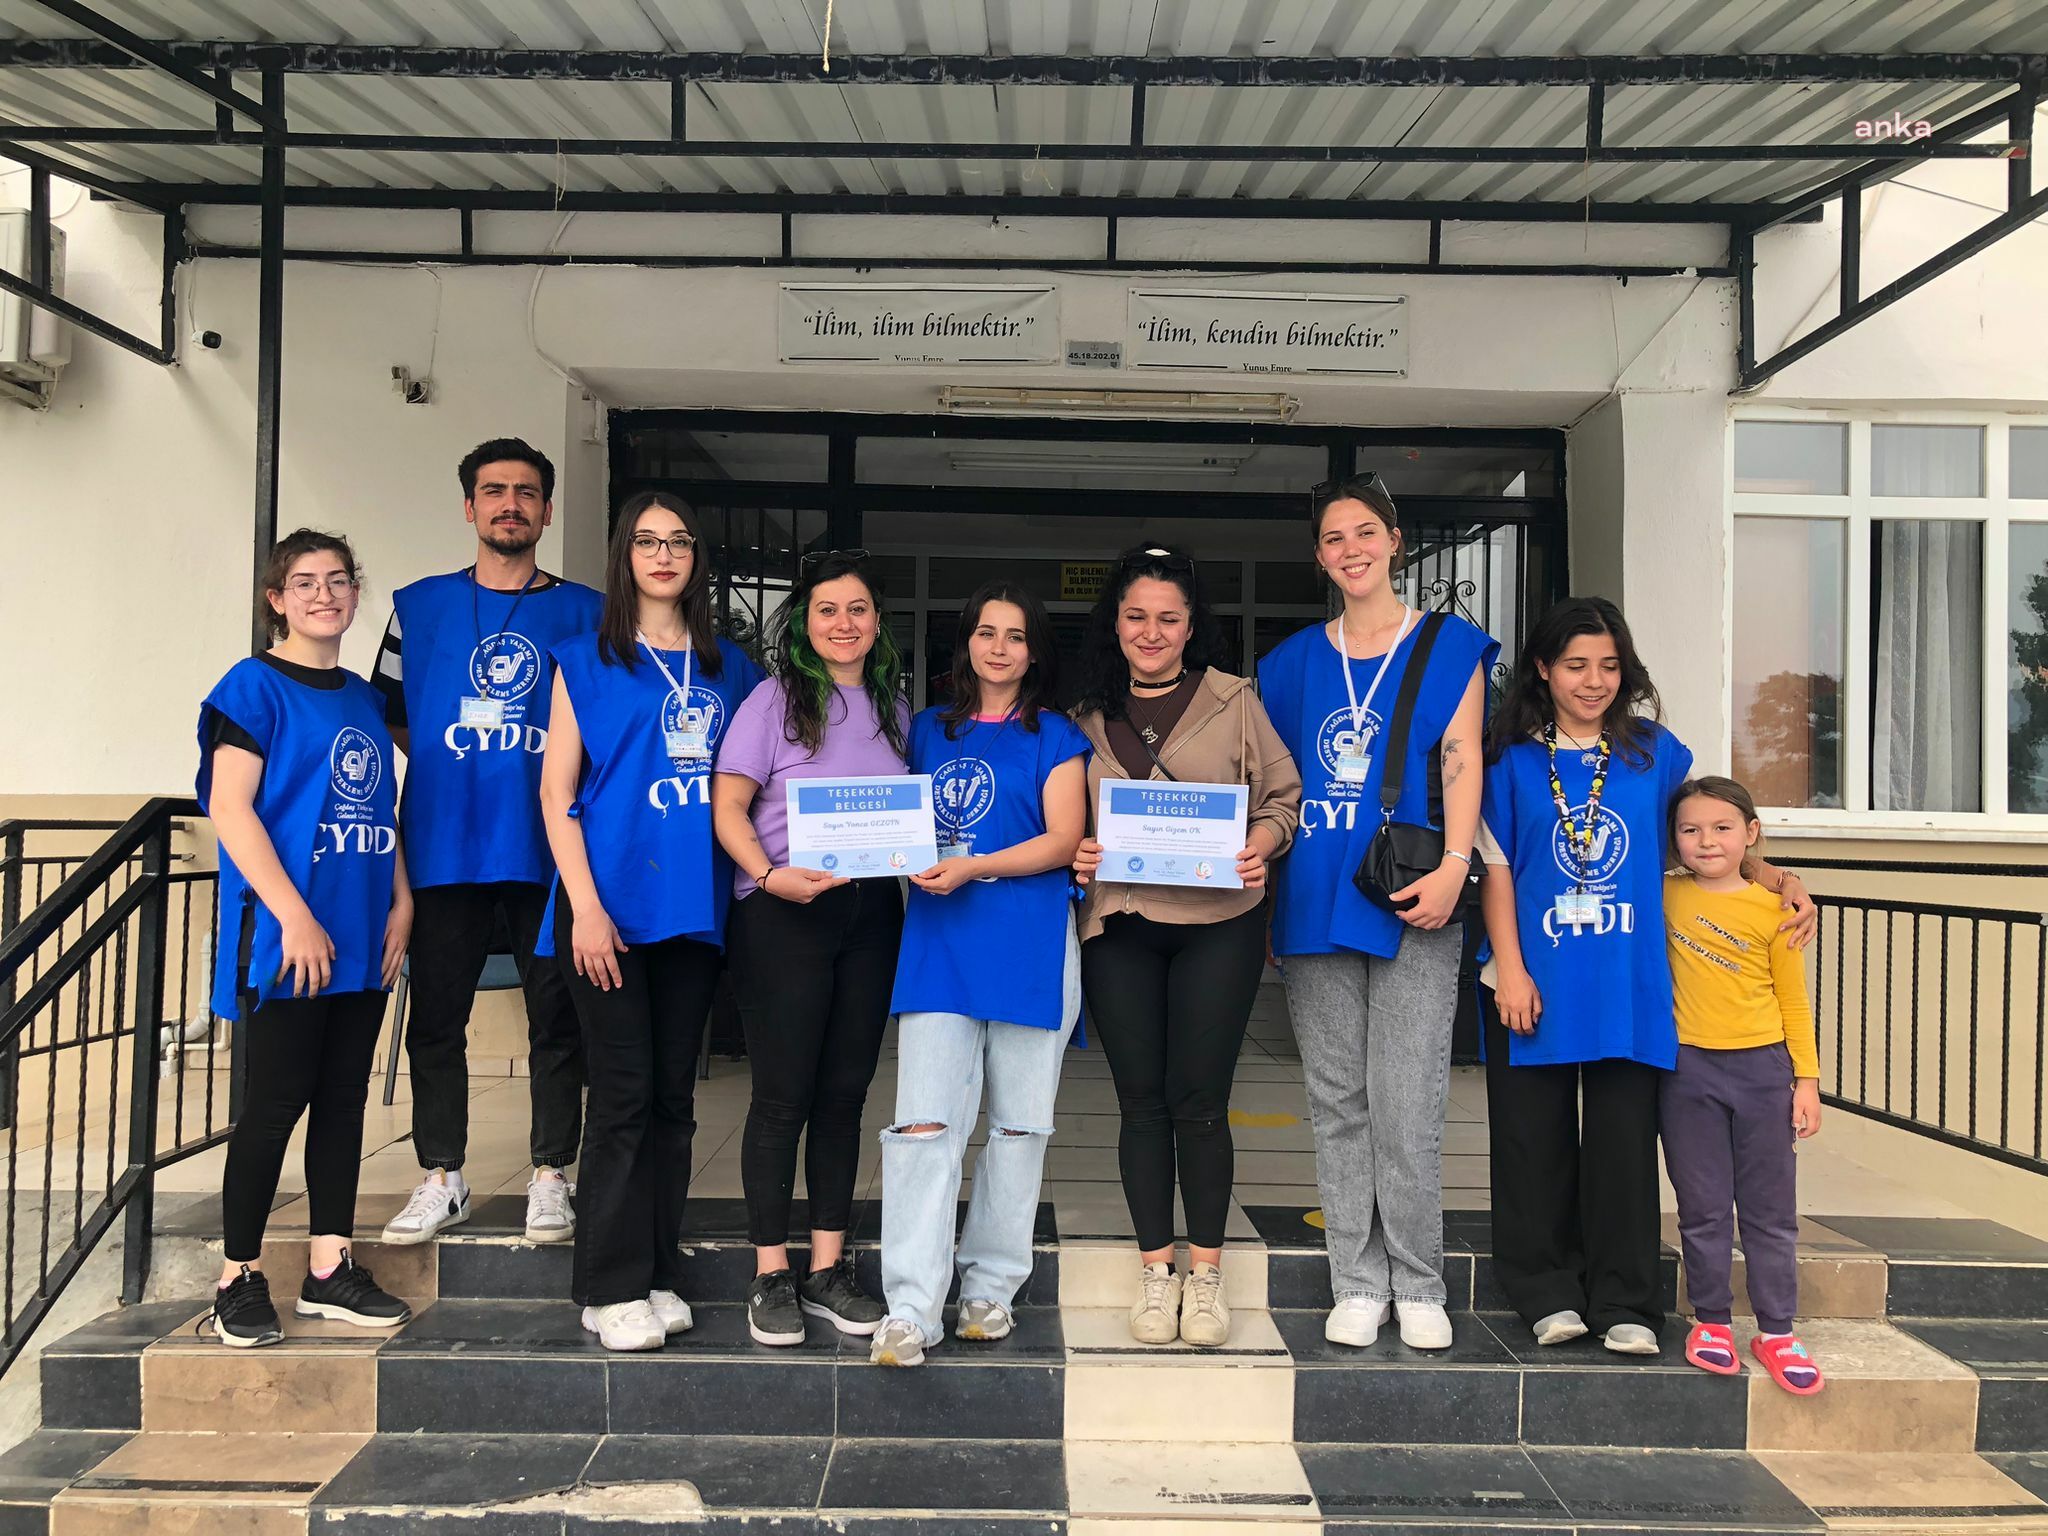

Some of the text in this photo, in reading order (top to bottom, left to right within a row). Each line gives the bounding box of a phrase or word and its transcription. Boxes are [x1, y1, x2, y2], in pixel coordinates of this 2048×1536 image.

[872, 311, 915, 337] ilim
[1206, 319, 1278, 346] kendin
[1068, 352, 1120, 360] 45.18.202.01
[1242, 362, 1292, 373] Yunus Emre
[444, 722, 549, 760] ÇYDD
[827, 786, 893, 798] TEŞEKKÜR
[1140, 790, 1208, 803] TEŞEKKÜR
[835, 798, 887, 811] BELGESİ
[1147, 804, 1200, 817] BELGESİ
[1142, 824, 1164, 834] Sayın
[1558, 841, 1600, 876] DESTEKLME
